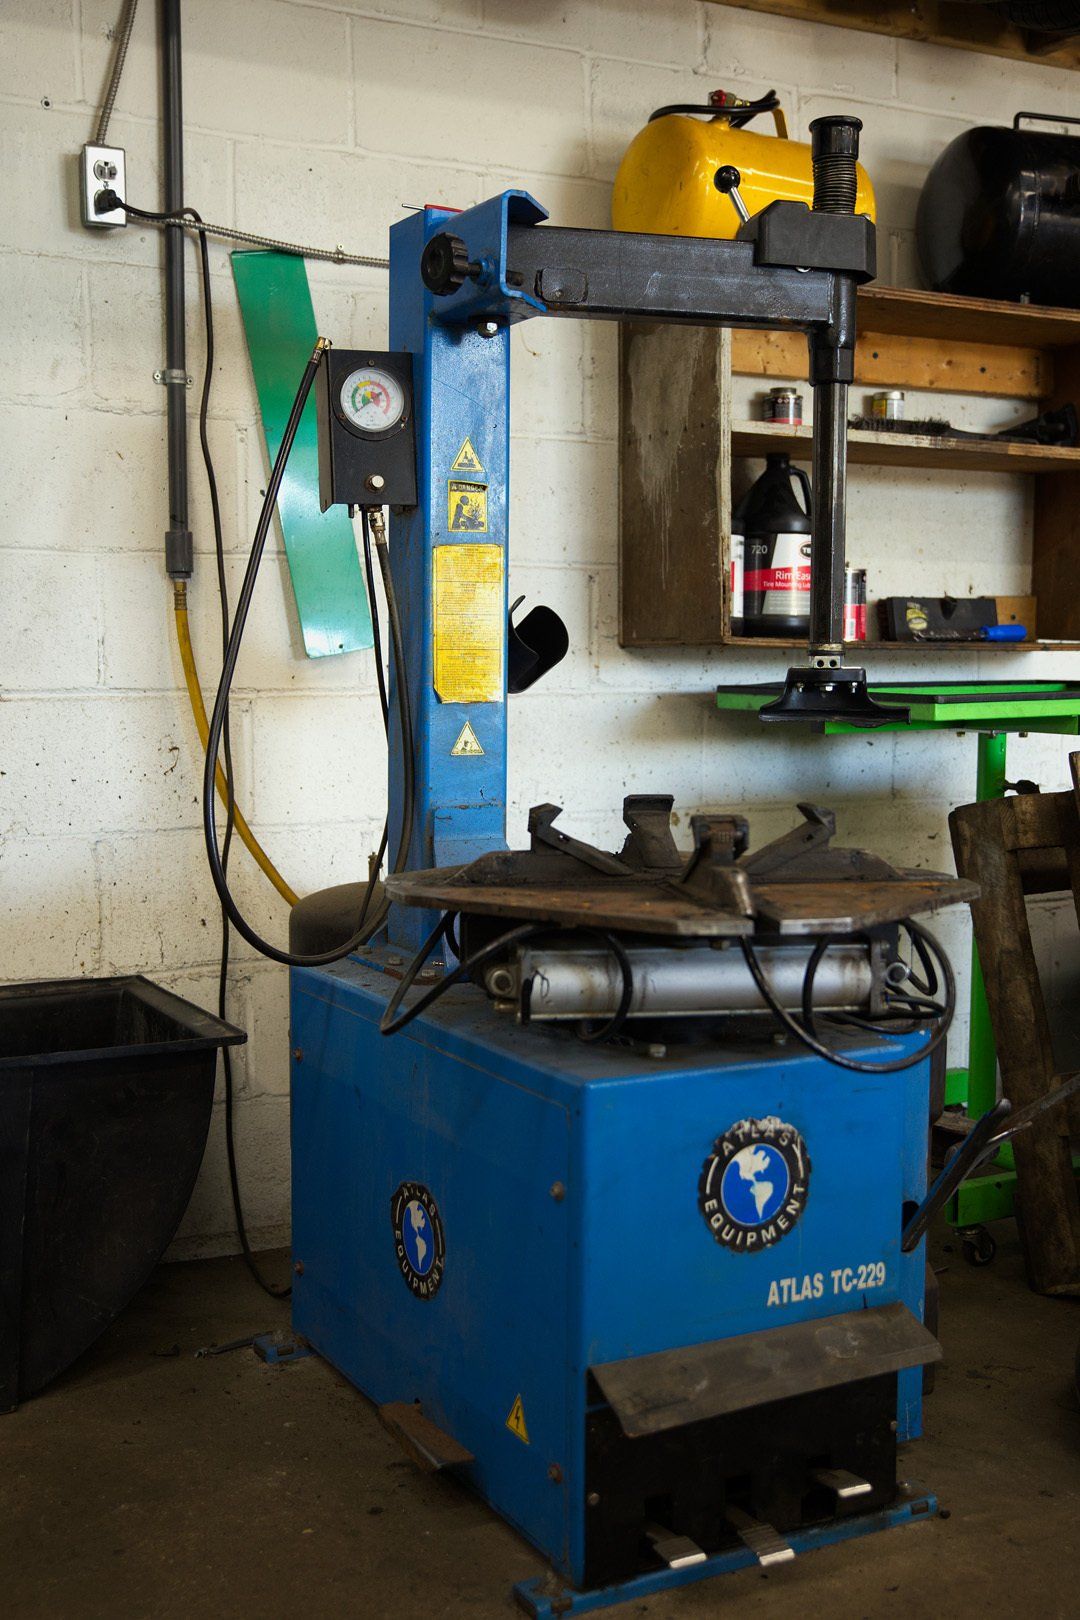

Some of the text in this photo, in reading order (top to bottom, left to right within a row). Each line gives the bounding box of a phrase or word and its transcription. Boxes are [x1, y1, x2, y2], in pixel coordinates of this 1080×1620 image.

[751, 545, 768, 554] 720
[775, 570, 793, 580] Rim
[722, 1122, 791, 1157] ATLAS
[403, 1184, 436, 1217] ATLAS
[704, 1183, 805, 1247] EQUIPMENT
[395, 1230, 444, 1295] EQUIPMENT
[767, 1261, 886, 1307] ATLAS TC-229
